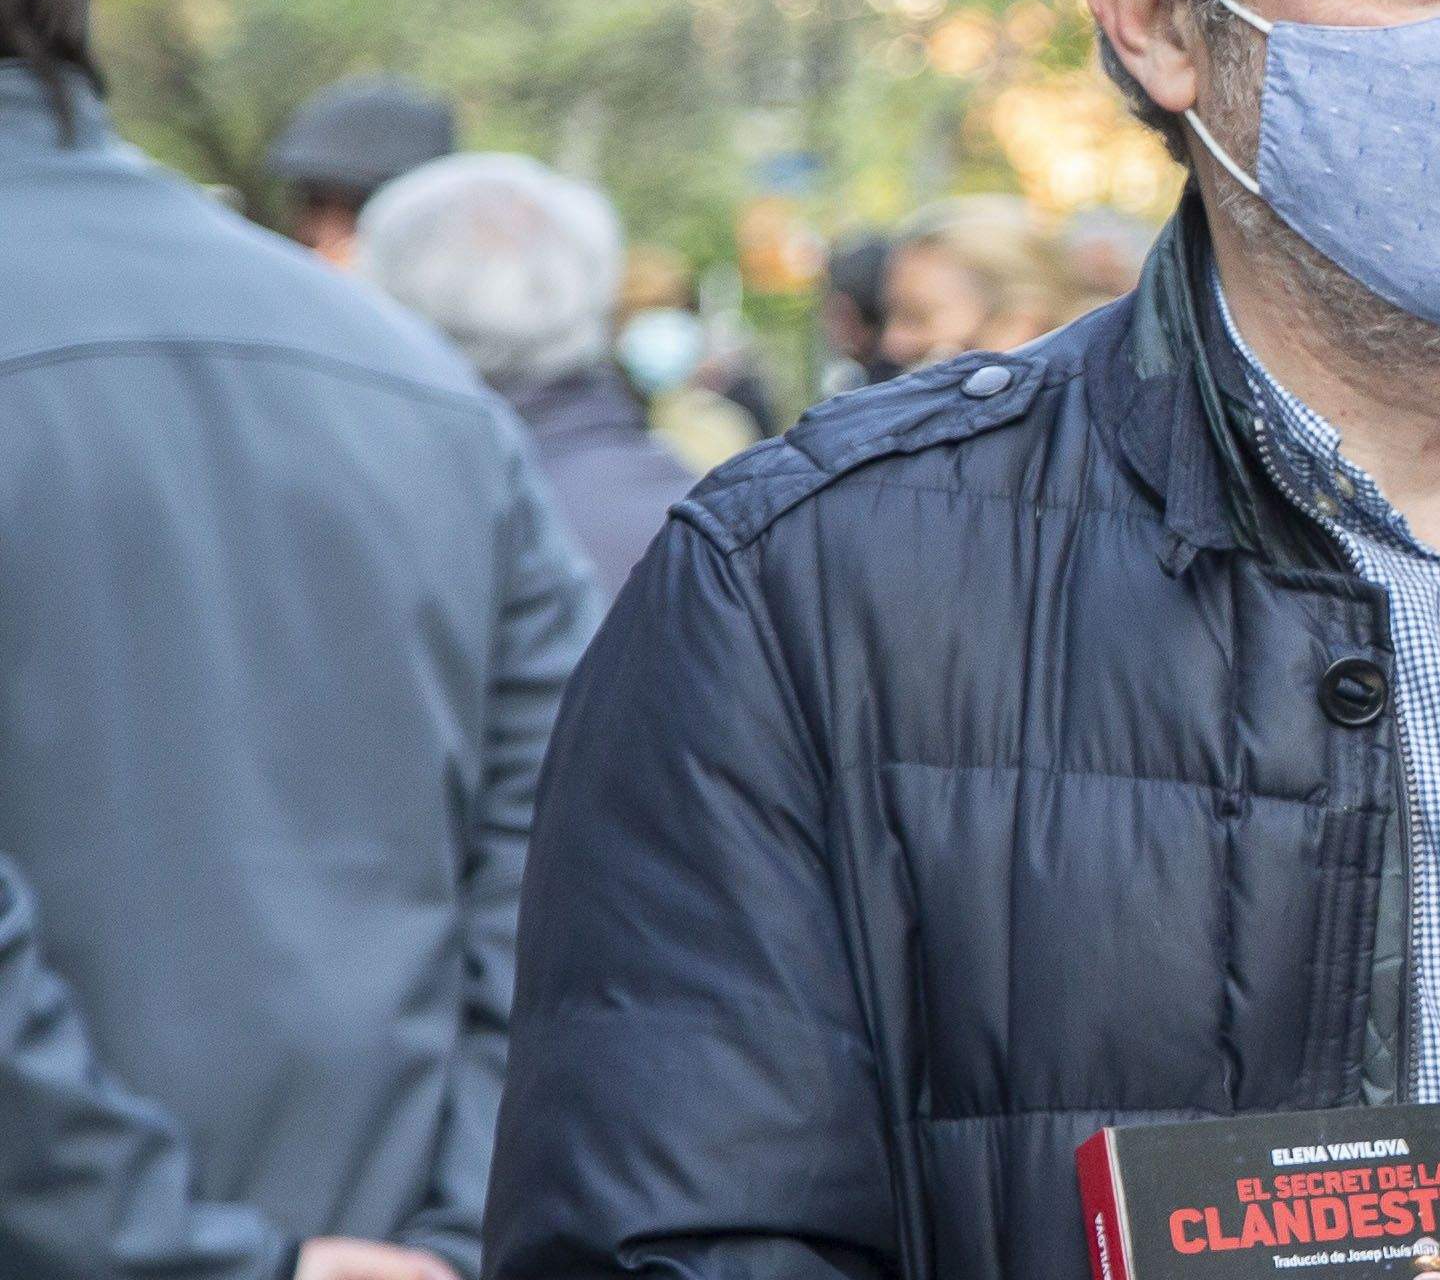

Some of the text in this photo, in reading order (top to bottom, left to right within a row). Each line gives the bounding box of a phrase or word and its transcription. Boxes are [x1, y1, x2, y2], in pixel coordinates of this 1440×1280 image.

[1271, 1138, 1410, 1166] ELENA VAVILOVA
[1236, 1178, 1271, 1203] EL
[1274, 1168, 1373, 1199] SECRET
[1377, 1164, 1415, 1190] DE
[1272, 1251, 1330, 1269] Traducció
[1330, 1249, 1345, 1265] de
[1346, 1246, 1382, 1265] Josep
[1383, 1243, 1411, 1260] Lluís
